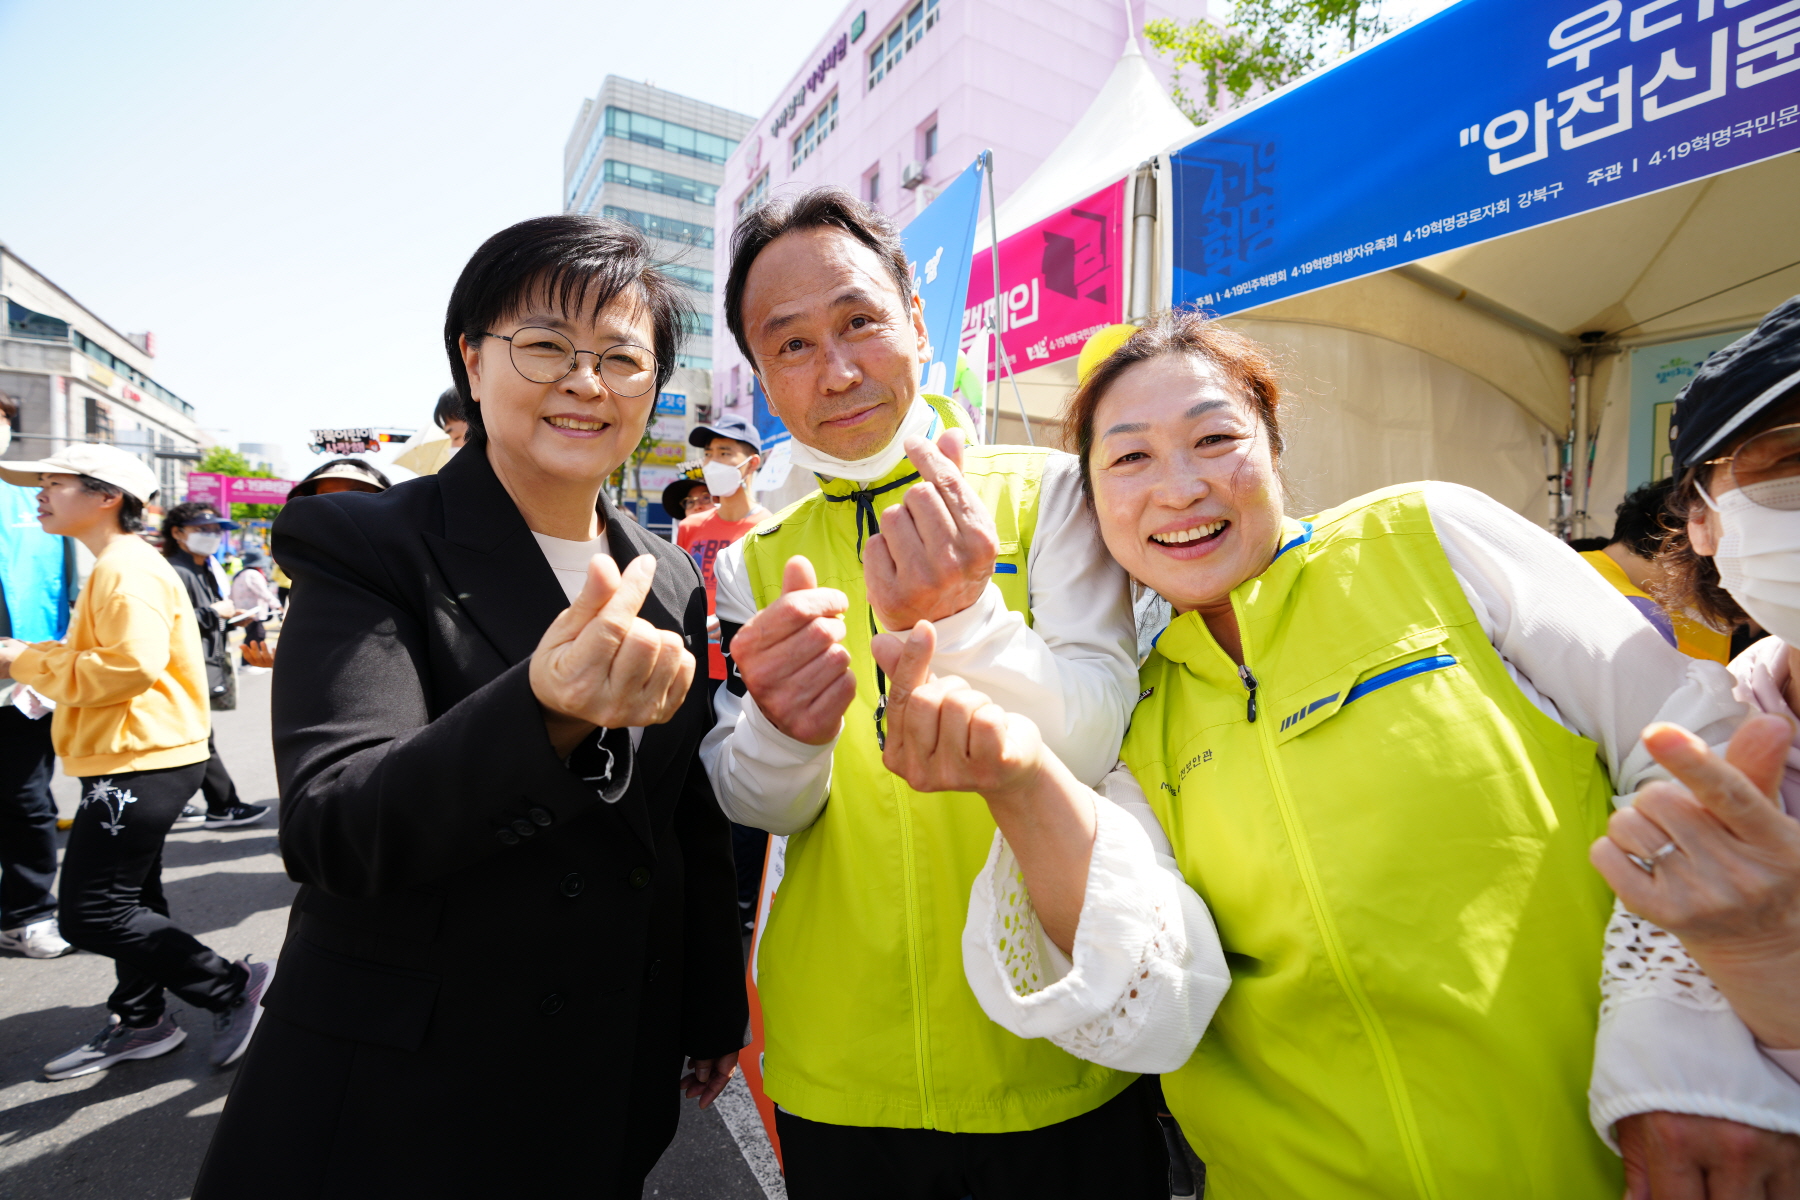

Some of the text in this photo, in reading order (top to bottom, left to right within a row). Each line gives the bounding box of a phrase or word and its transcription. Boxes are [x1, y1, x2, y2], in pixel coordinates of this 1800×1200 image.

[1403, 197, 1510, 243] 4·19혁명공로자회
[1517, 181, 1564, 209] 강북구
[1587, 161, 1624, 187] 주관
